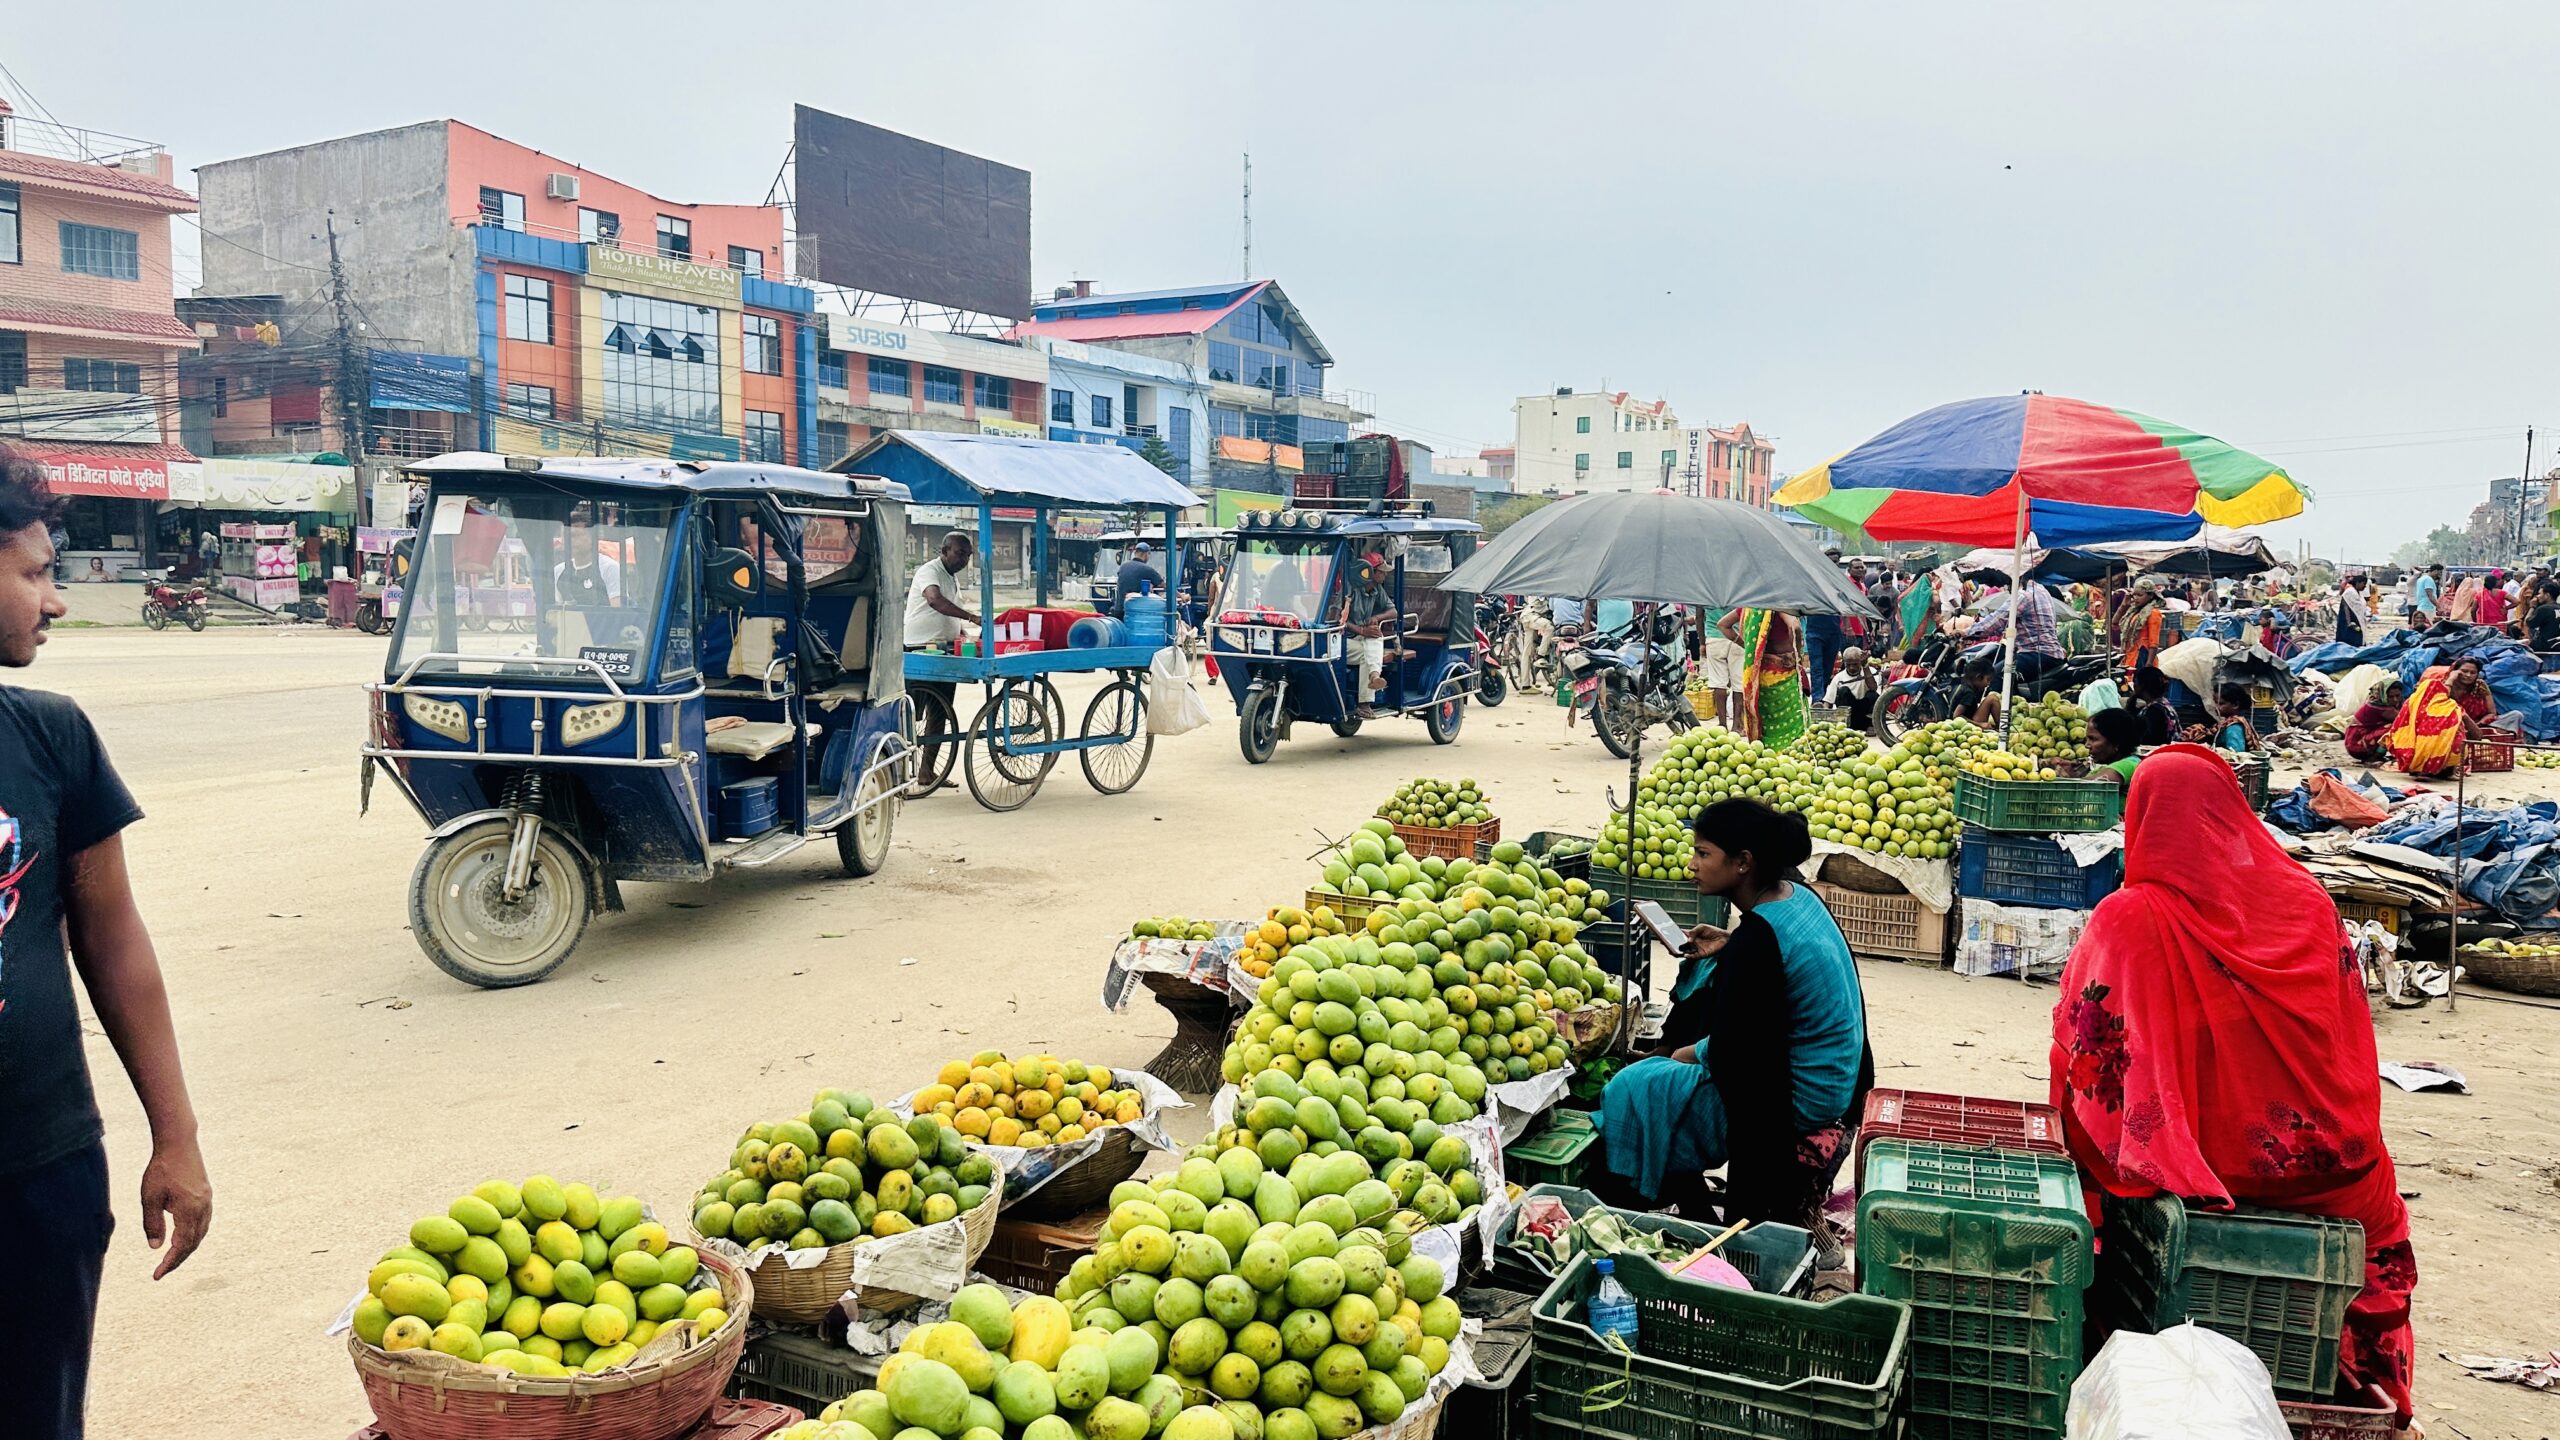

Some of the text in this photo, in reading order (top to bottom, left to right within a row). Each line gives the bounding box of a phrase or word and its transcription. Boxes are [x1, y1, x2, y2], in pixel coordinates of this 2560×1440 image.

[598, 248, 736, 284] HOTEL HEAVEN
[1690, 431, 1698, 467] HOTEL
[45, 461, 166, 492] ोला डिजिटल फोटो स्टुडियो
